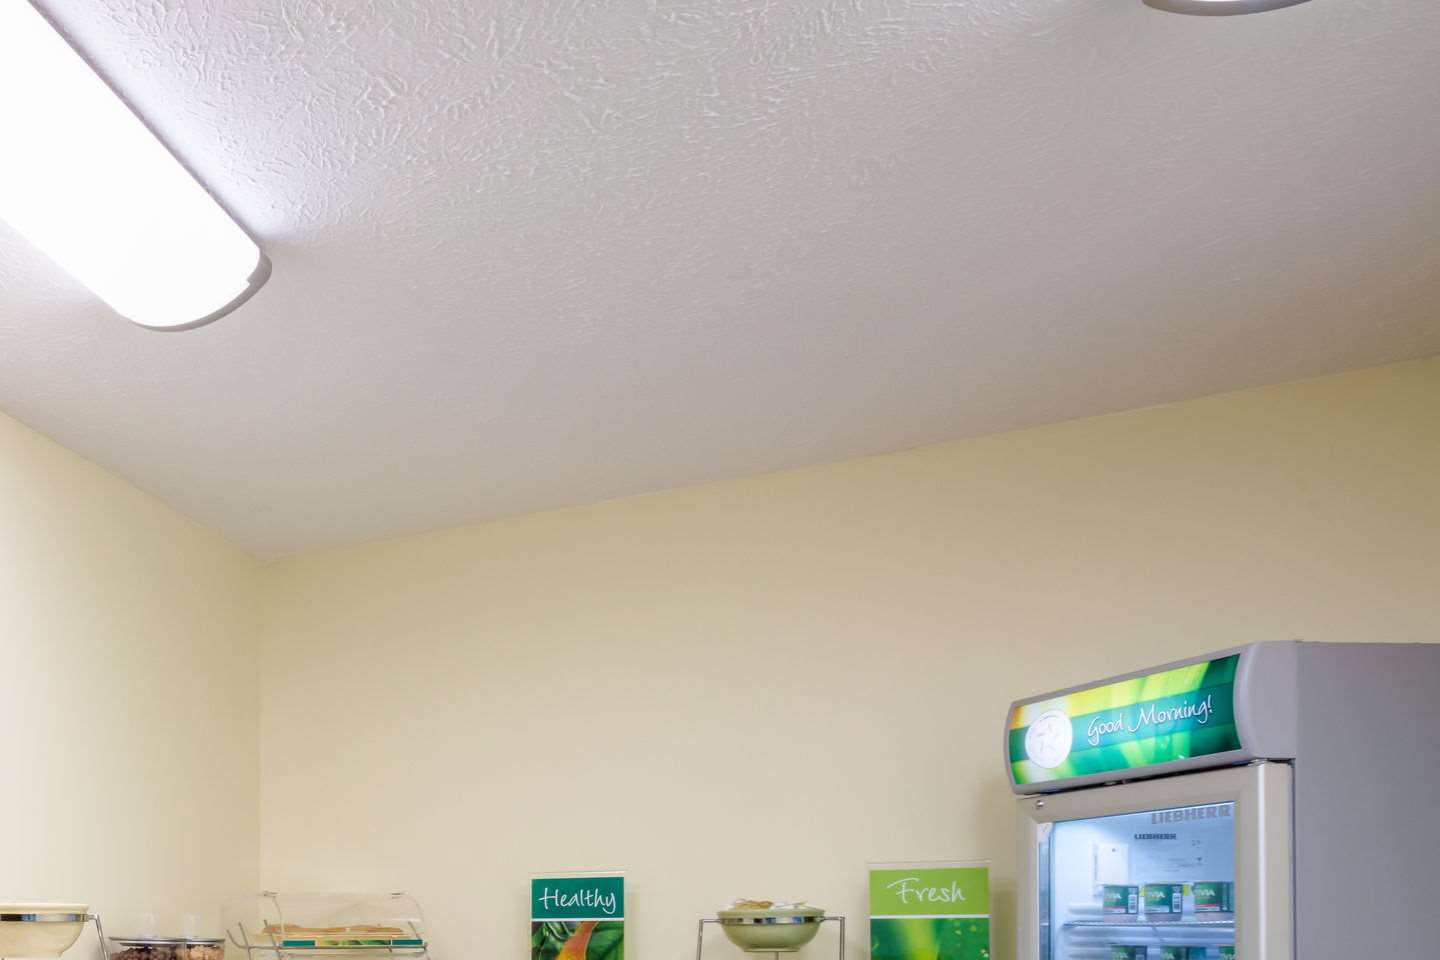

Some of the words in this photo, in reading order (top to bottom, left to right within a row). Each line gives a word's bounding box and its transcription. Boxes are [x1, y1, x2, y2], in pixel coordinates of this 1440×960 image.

[1087, 717, 1125, 746] Good
[1127, 694, 1213, 733] Morning!
[1151, 805, 1231, 825] LIEBHERR
[538, 887, 616, 915] Healthy
[886, 877, 966, 904] Fresh
